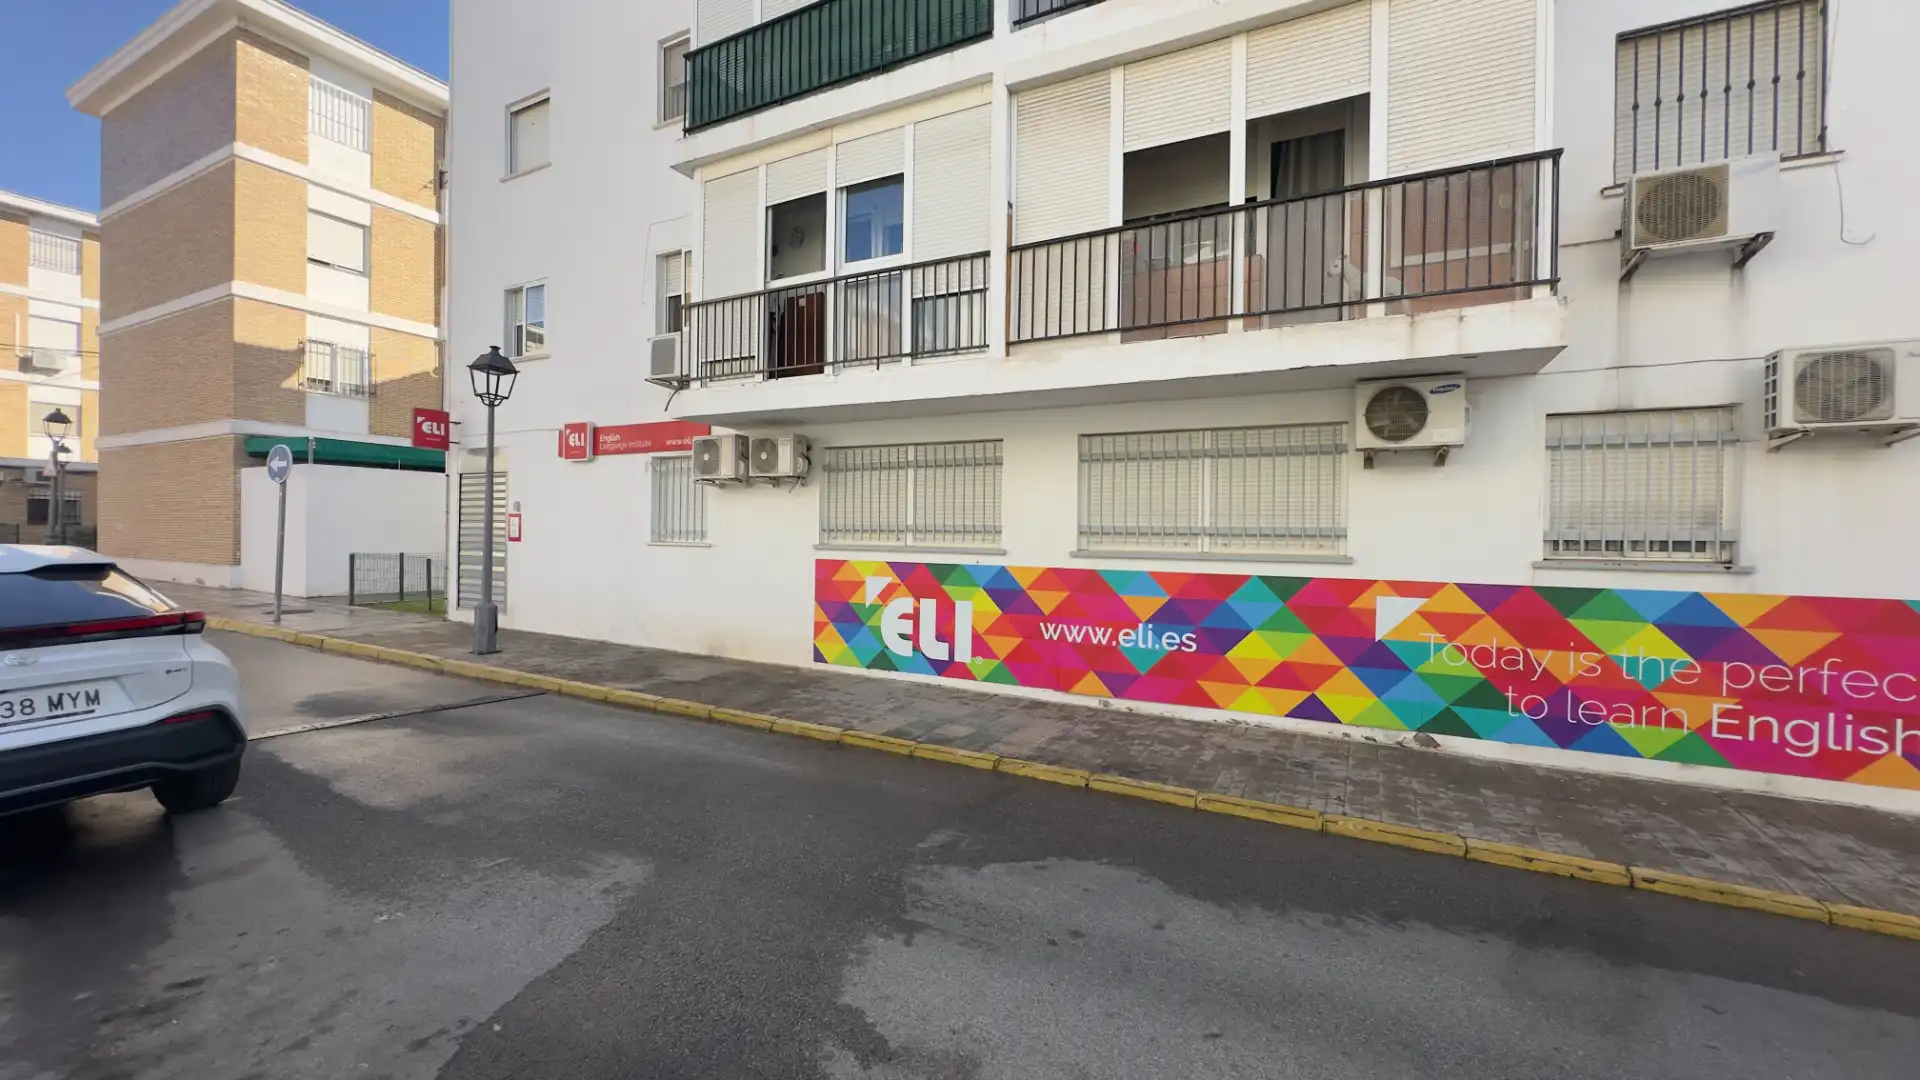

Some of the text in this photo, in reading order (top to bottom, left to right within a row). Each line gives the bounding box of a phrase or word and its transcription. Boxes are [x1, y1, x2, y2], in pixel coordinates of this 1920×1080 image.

[421, 421, 445, 436] ELI
[568, 431, 585, 447] ELI
[599, 433, 621, 443] English
[880, 596, 974, 663] ELI
[1039, 622, 1198, 653] www.eli.es
[1418, 632, 1918, 702] Today is the perfec
[0, 688, 101, 719] 38 MYM
[1504, 685, 1920, 757] to learn English
